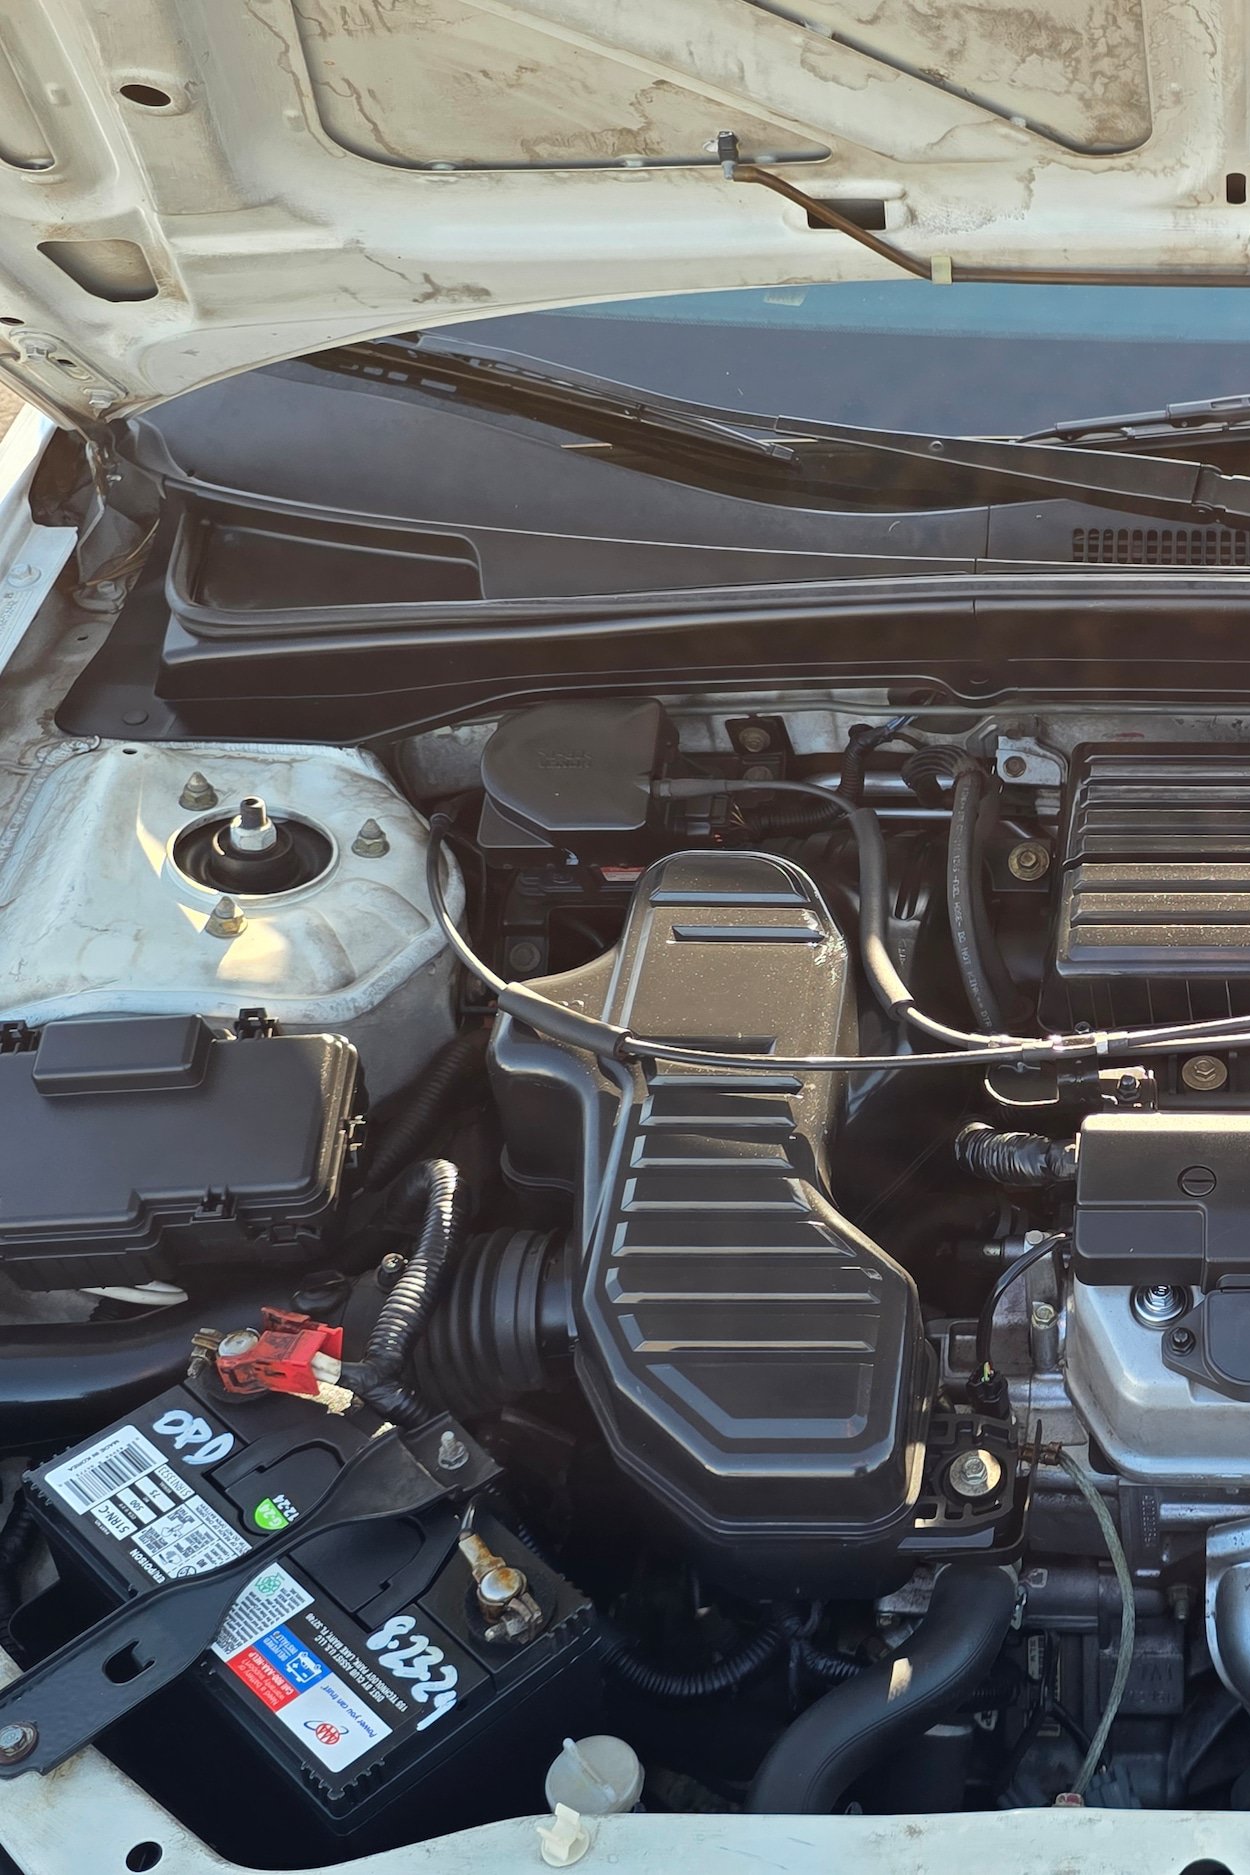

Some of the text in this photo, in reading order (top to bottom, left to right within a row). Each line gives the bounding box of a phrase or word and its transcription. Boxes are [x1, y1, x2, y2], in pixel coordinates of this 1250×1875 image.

[149, 1490, 160, 1498] 75
[130, 1500, 143, 1510] 500
[98, 1505, 129, 1532] 51RN-C
[320, 1626, 329, 1635] FL
[314, 1635, 327, 1646] LLC
[339, 1646, 355, 1660] LAKE
[332, 1653, 353, 1670] ASSIST
[244, 1668, 265, 1688] battery
[349, 1668, 365, 1683] CLUB
[280, 1683, 293, 1694] Call
[361, 1681, 372, 1690] BY
[365, 1672, 398, 1703] TECHNOLOGY
[263, 1690, 278, 1705] Need
[336, 1698, 348, 1708] can
[346, 1708, 361, 1720] you
[316, 1724, 340, 1744] AAA
[357, 1720, 376, 1737] Power
